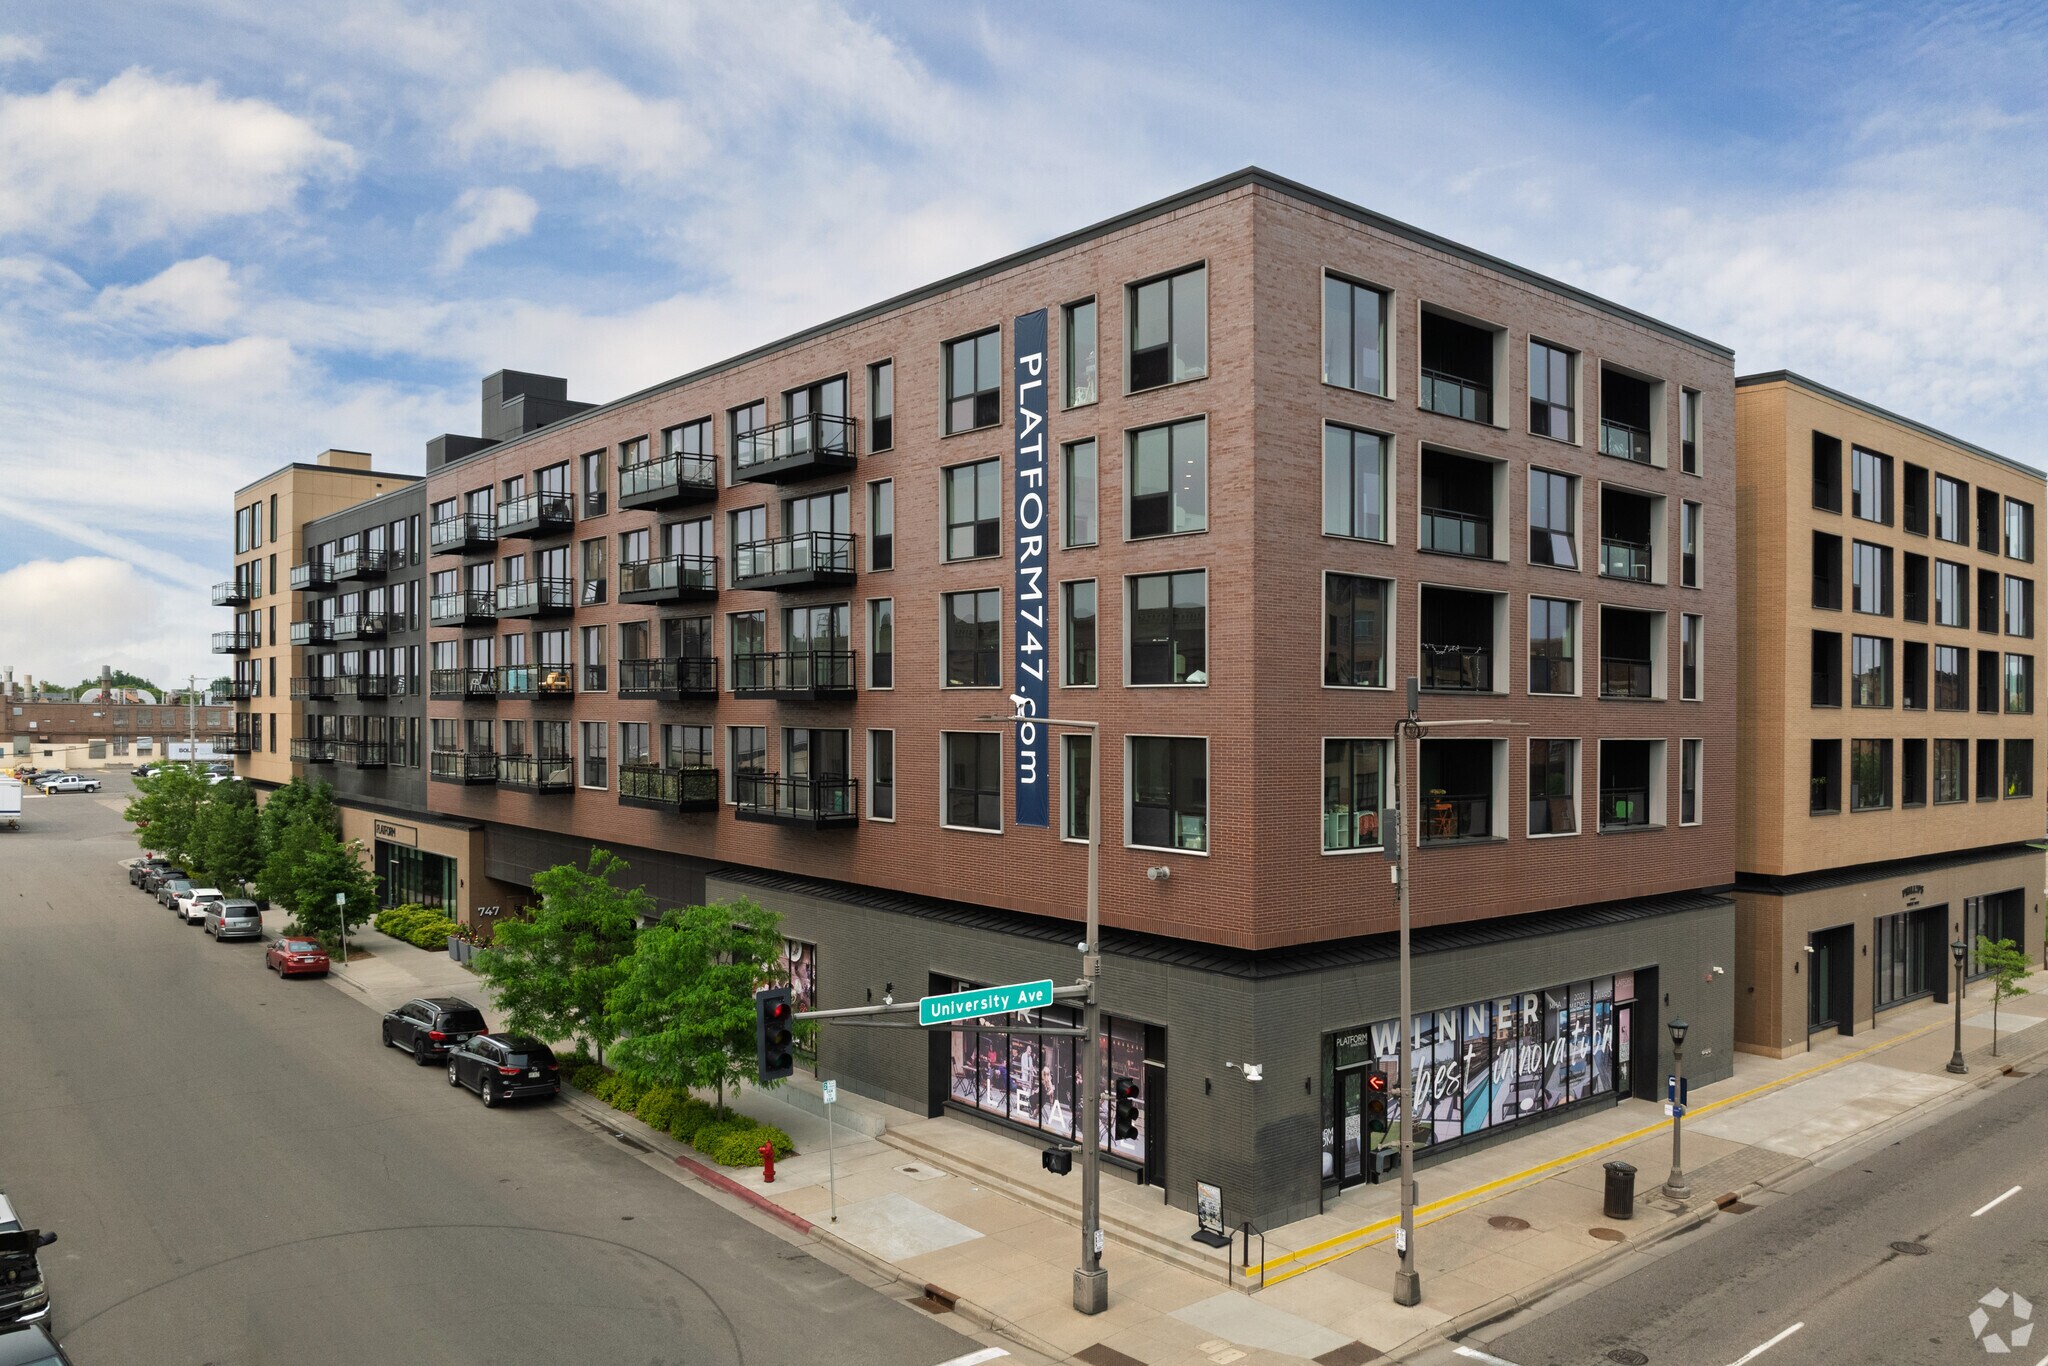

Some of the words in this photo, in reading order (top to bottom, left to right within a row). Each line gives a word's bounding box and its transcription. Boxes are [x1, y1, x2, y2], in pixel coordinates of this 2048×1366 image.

[1019, 352, 1043, 784] PLATFORM747.com
[376, 824, 396, 838] PLATFORM
[477, 906, 500, 917] 747
[931, 995, 1009, 1017] University
[1017, 990, 1043, 1004] Ave
[1371, 994, 1539, 1057] WINNER
[1336, 1033, 1368, 1047] PLATFORM
[1413, 1044, 1477, 1111] best
[1494, 1020, 1613, 1084] innovation
